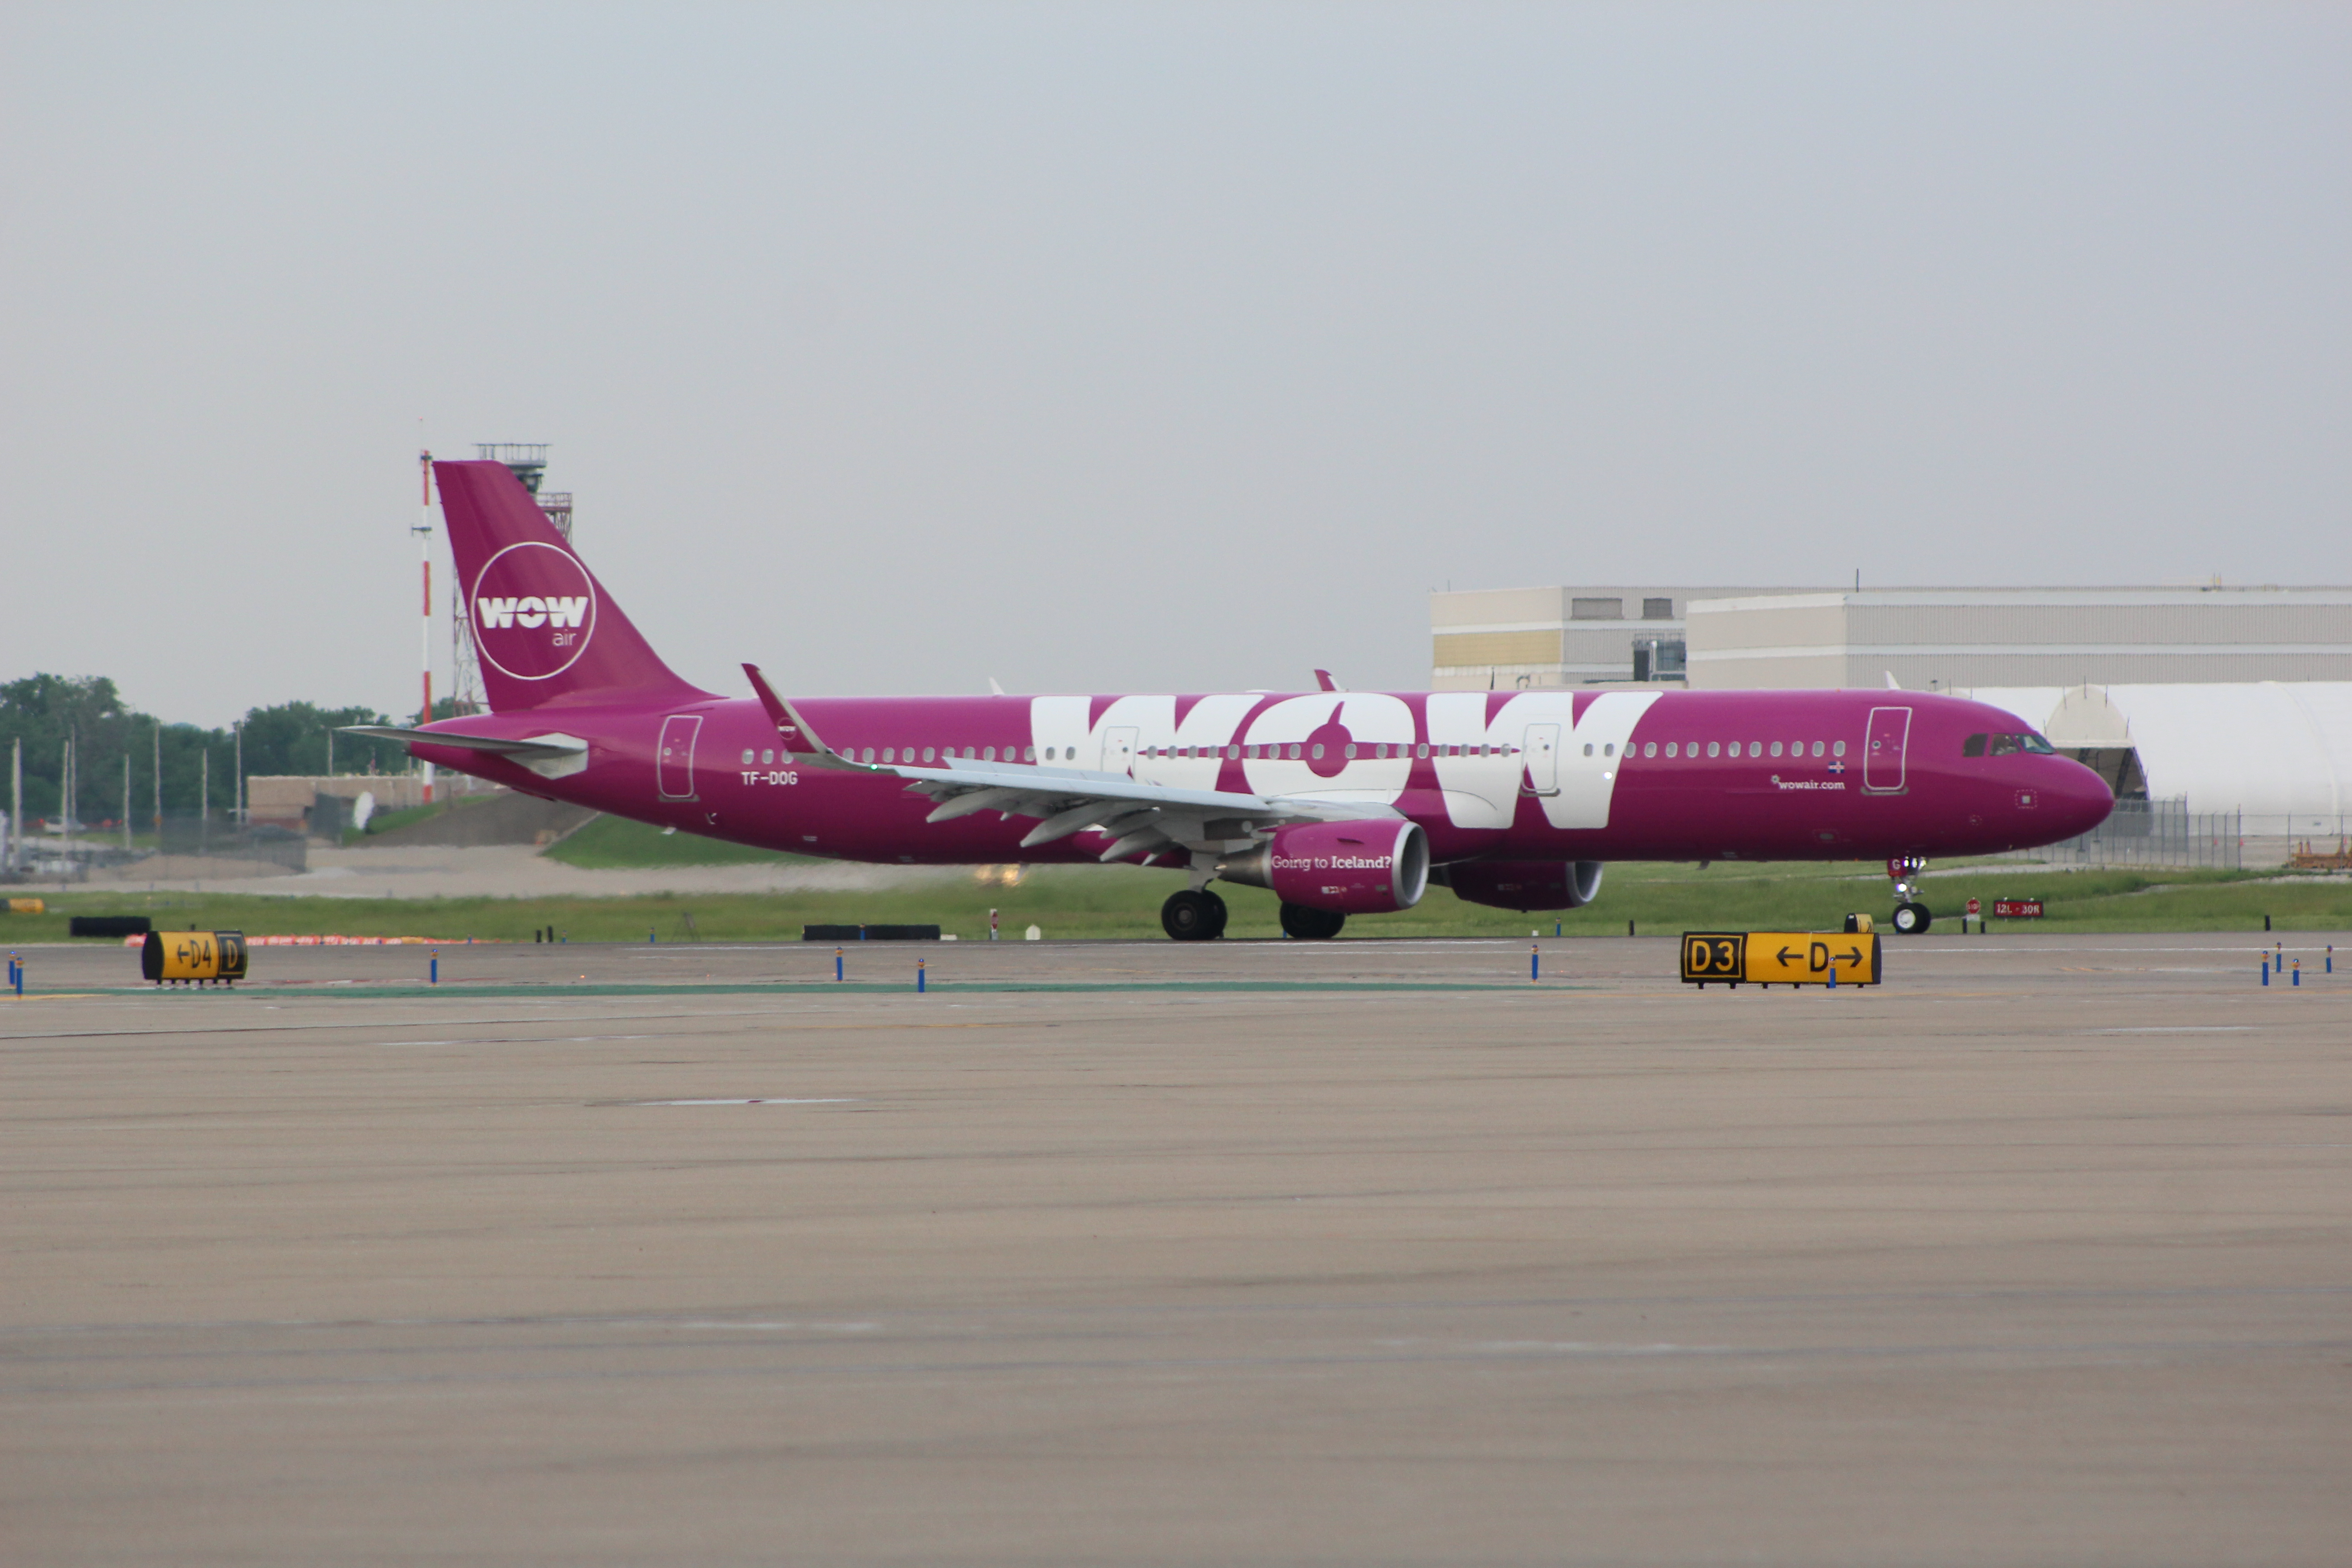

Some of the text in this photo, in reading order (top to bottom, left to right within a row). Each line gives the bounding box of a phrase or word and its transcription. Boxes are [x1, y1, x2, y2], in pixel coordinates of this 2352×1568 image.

[478, 596, 589, 629] WOW
[552, 629, 577, 647] air
[1030, 691, 1664, 830] WOW
[741, 771, 798, 785] TF-DOG
[1779, 779, 1845, 789] wowair.com
[1272, 855, 1392, 872] Going to Iceland?
[1892, 859, 1901, 870] G
[1997, 904, 2012, 913] 12L
[2022, 905, 2039, 914] 30R
[191, 939, 238, 969] D4 D
[1810, 942, 1829, 972] D
